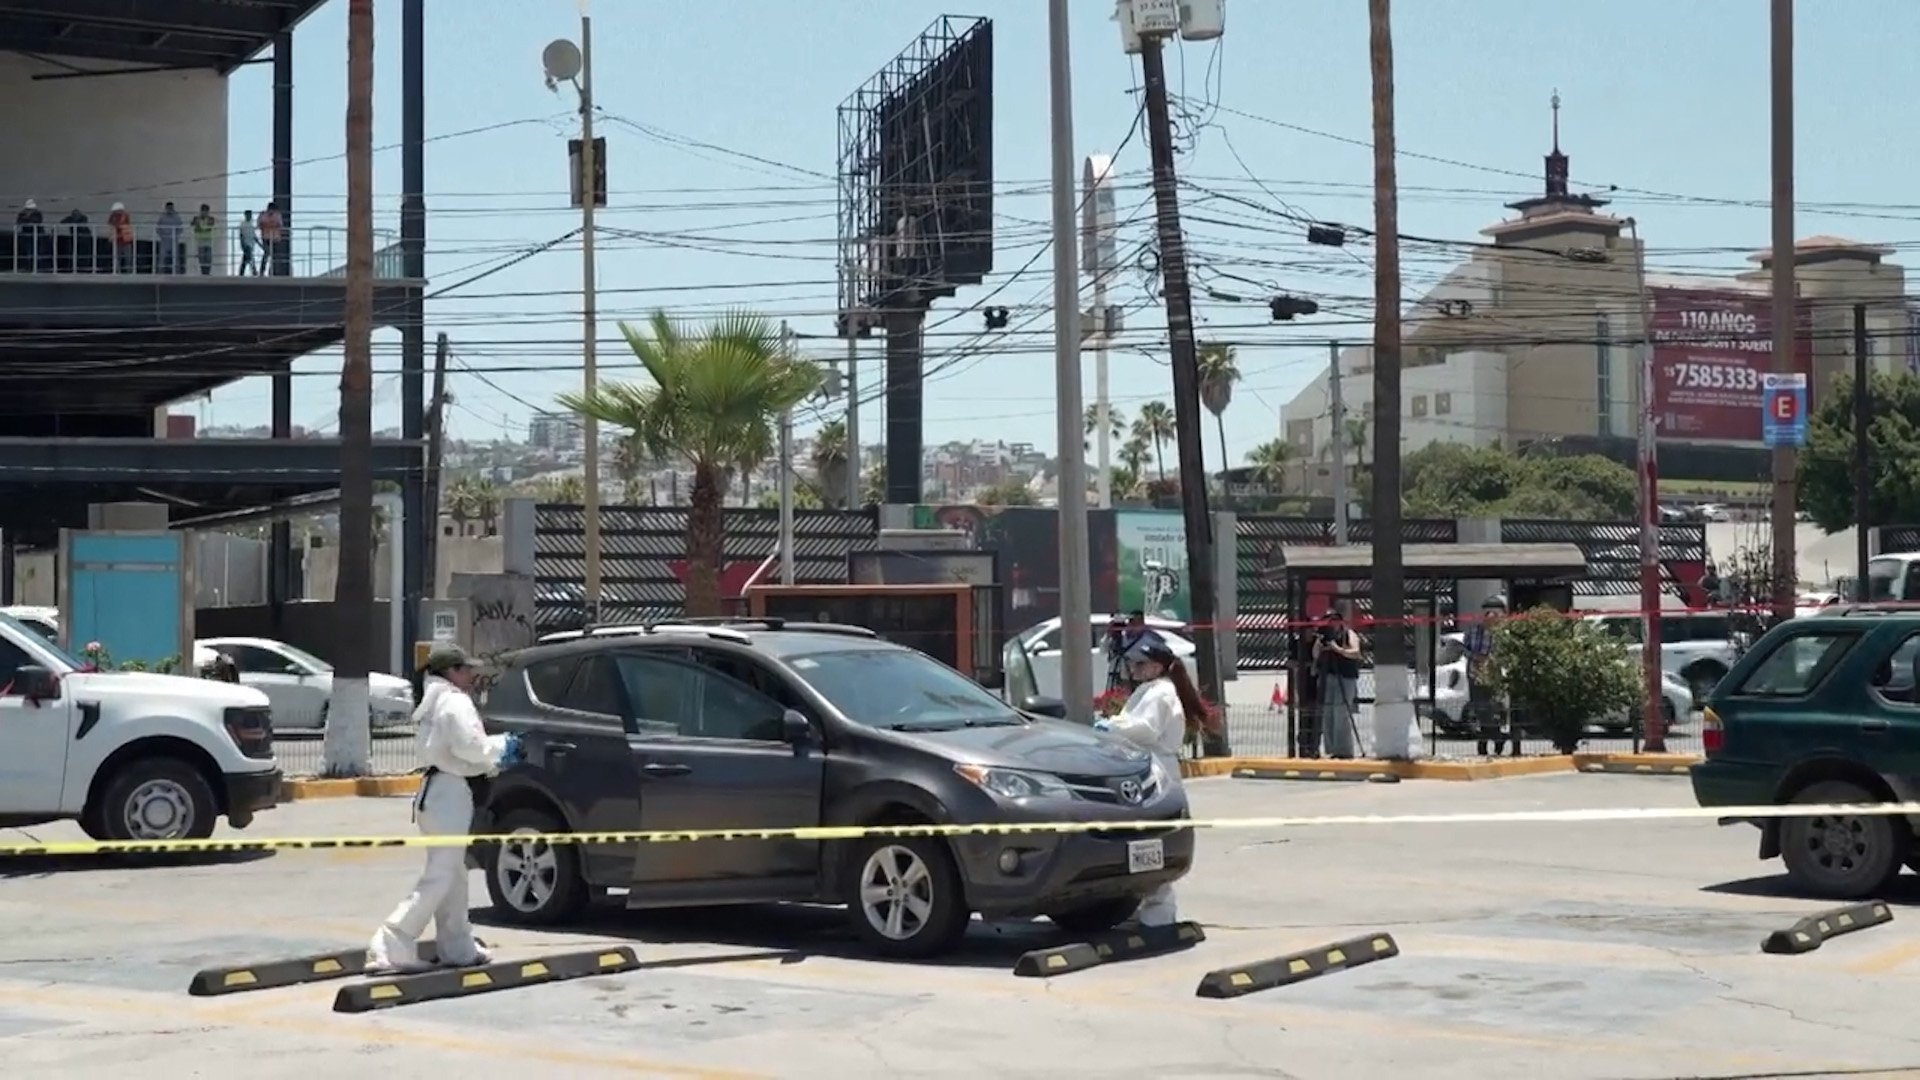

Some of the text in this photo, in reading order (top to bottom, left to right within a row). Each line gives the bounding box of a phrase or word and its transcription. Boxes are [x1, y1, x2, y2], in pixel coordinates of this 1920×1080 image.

[1680, 309, 1756, 333] 110 AÑOS
[1777, 397, 1791, 418] E
